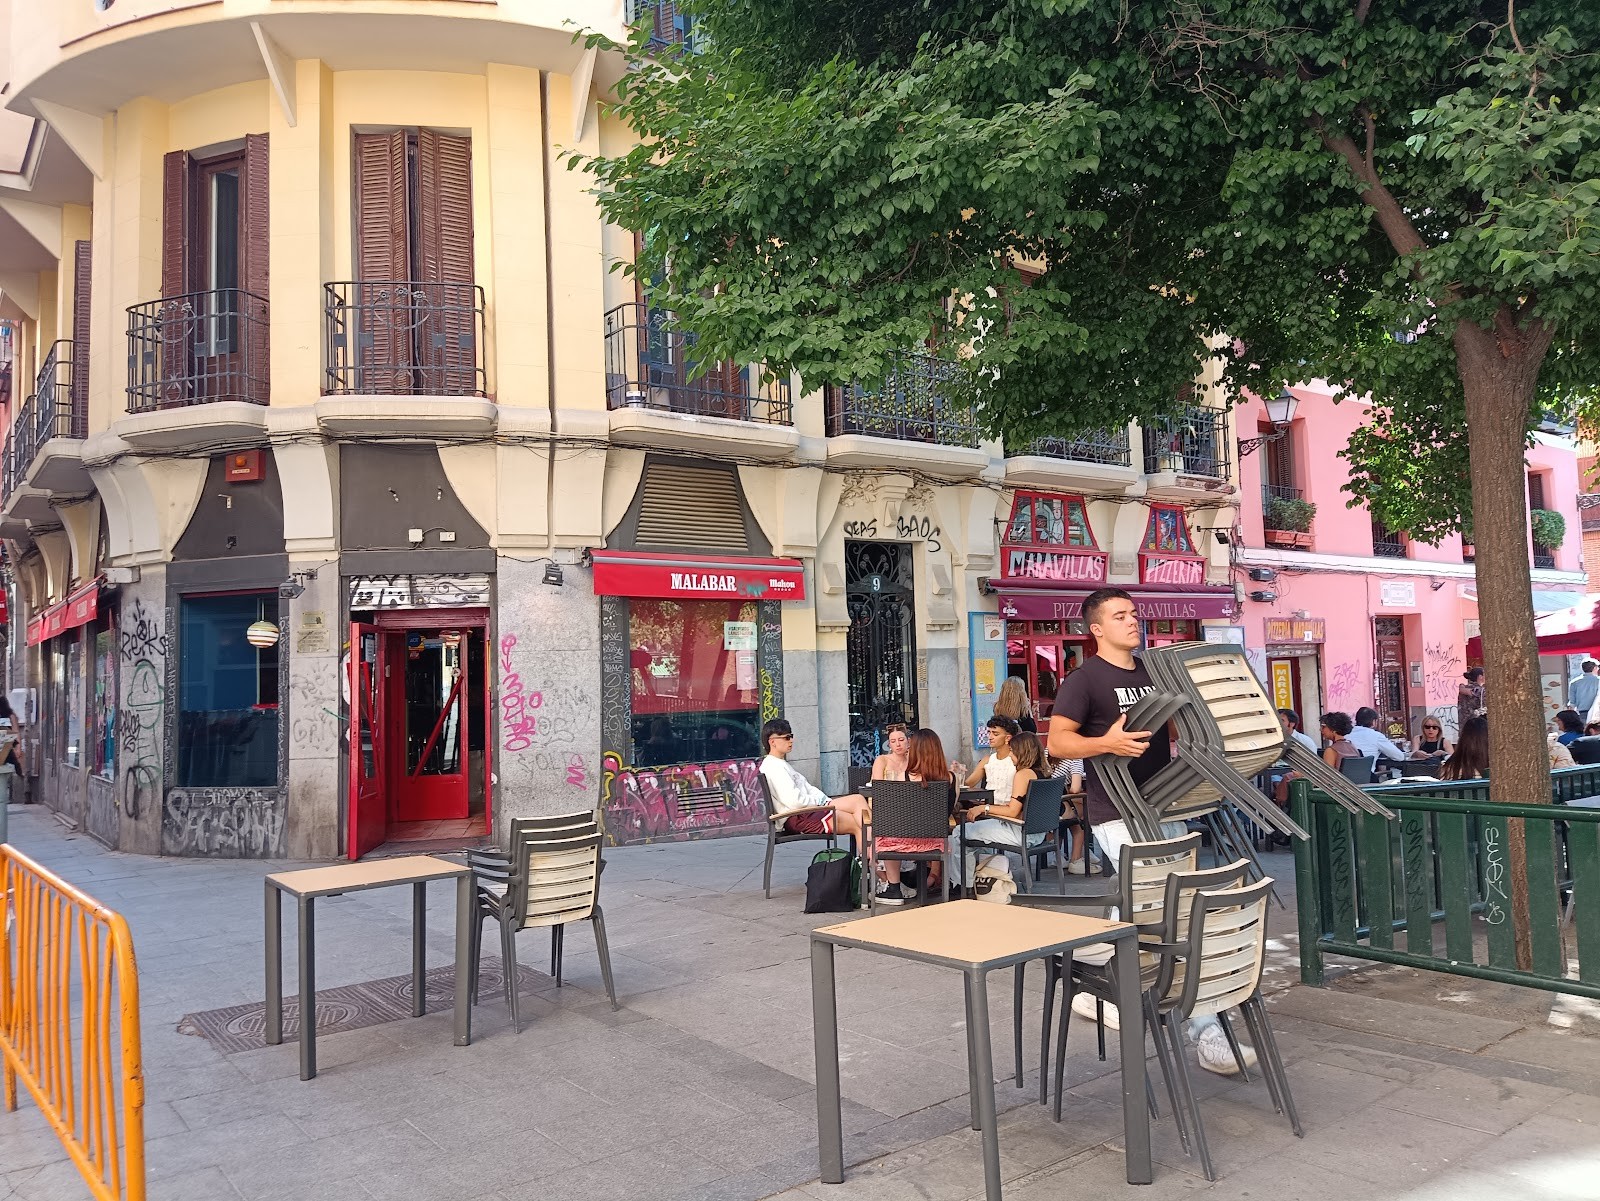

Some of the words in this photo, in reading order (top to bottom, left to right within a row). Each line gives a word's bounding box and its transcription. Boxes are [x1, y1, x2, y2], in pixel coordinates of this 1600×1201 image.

[670, 573, 738, 592] MALABAR
[872, 577, 881, 591] 9
[1052, 602, 1084, 618] PIZZ
[1136, 602, 1197, 618] RAVILLAS
[1276, 669, 1287, 710] MARAVI
